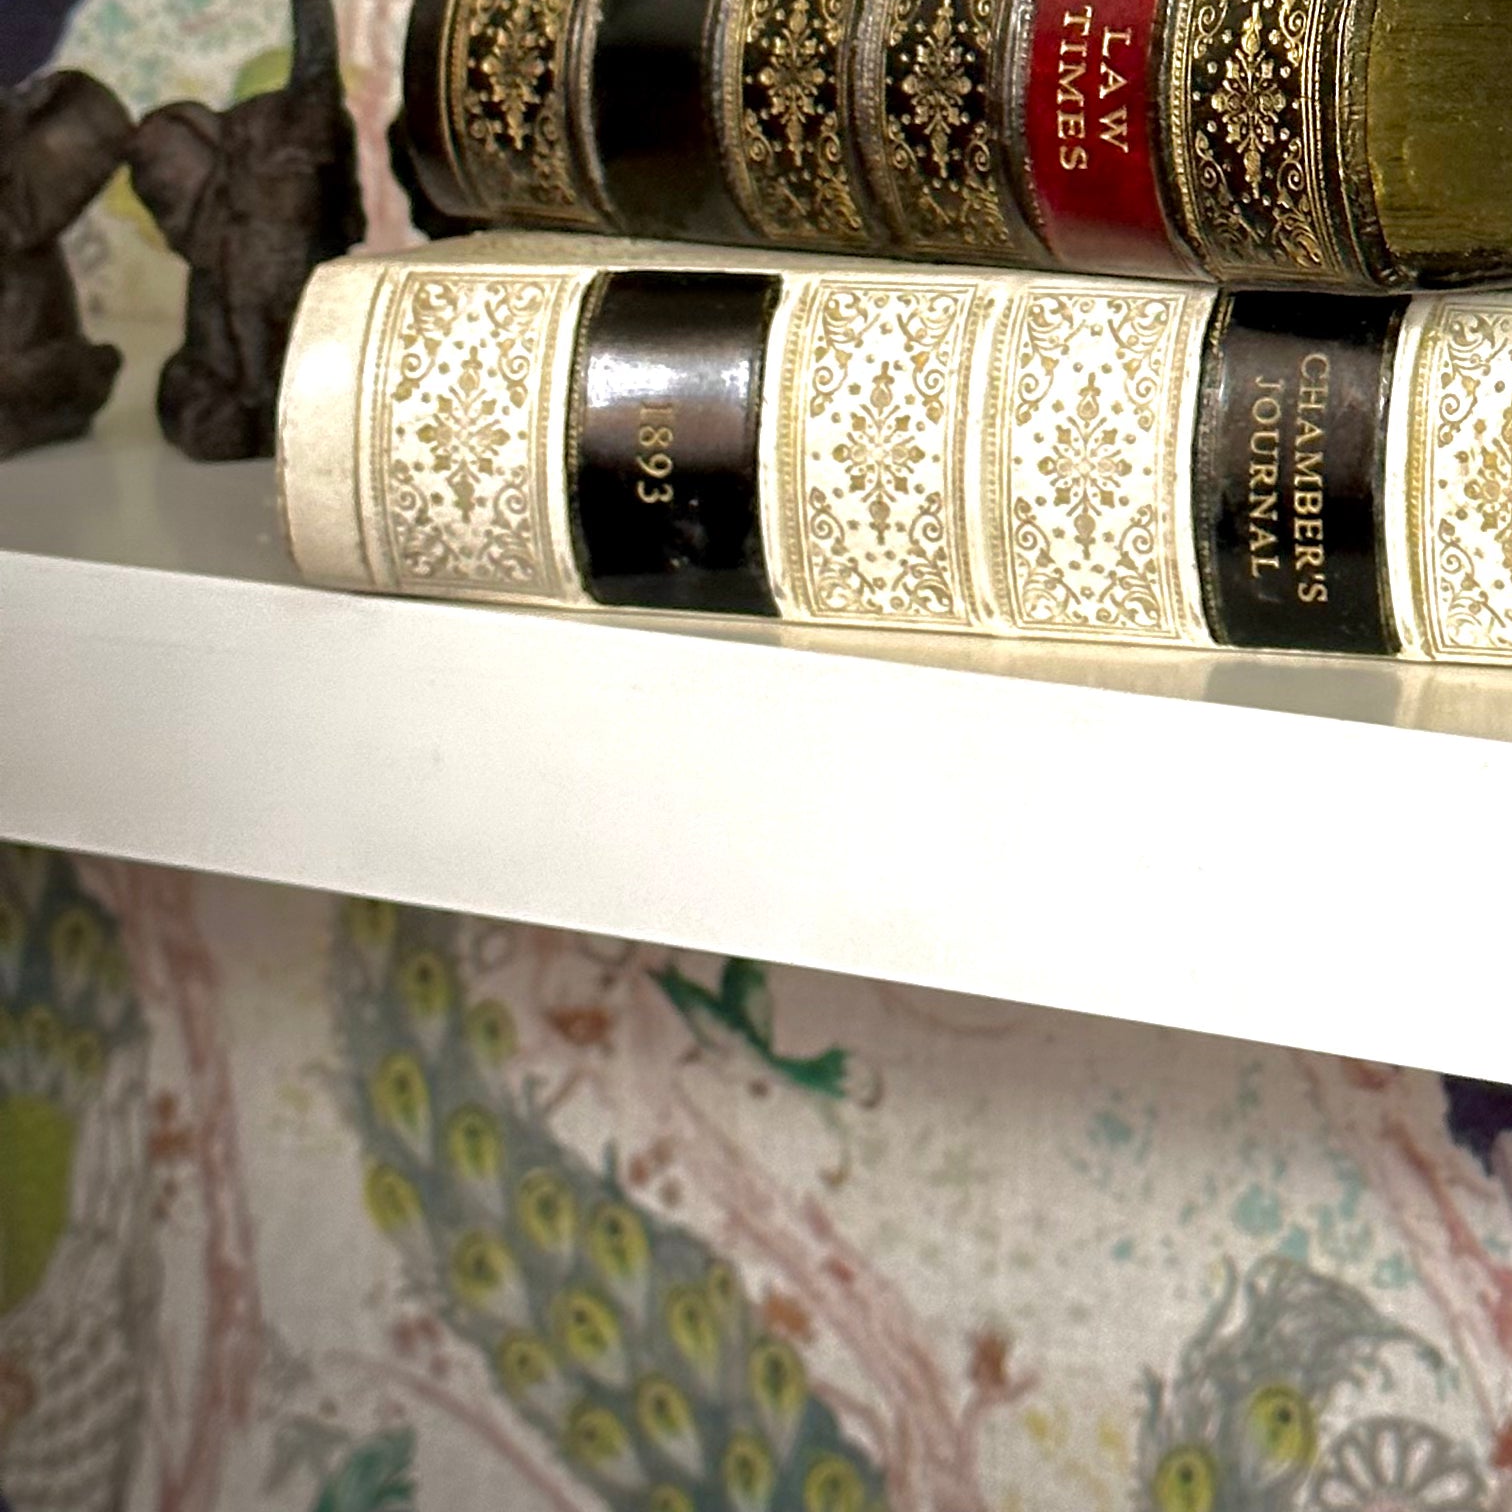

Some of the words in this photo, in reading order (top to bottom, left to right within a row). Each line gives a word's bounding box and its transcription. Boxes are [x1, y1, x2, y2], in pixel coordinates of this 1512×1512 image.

[1056, 5, 1093, 171] TIMES
[1098, 26, 1133, 154] LAW
[635, 404, 675, 503] 1893
[1248, 375, 1284, 578] JOURNAL
[1293, 353, 1331, 603] CHAMBER'S
